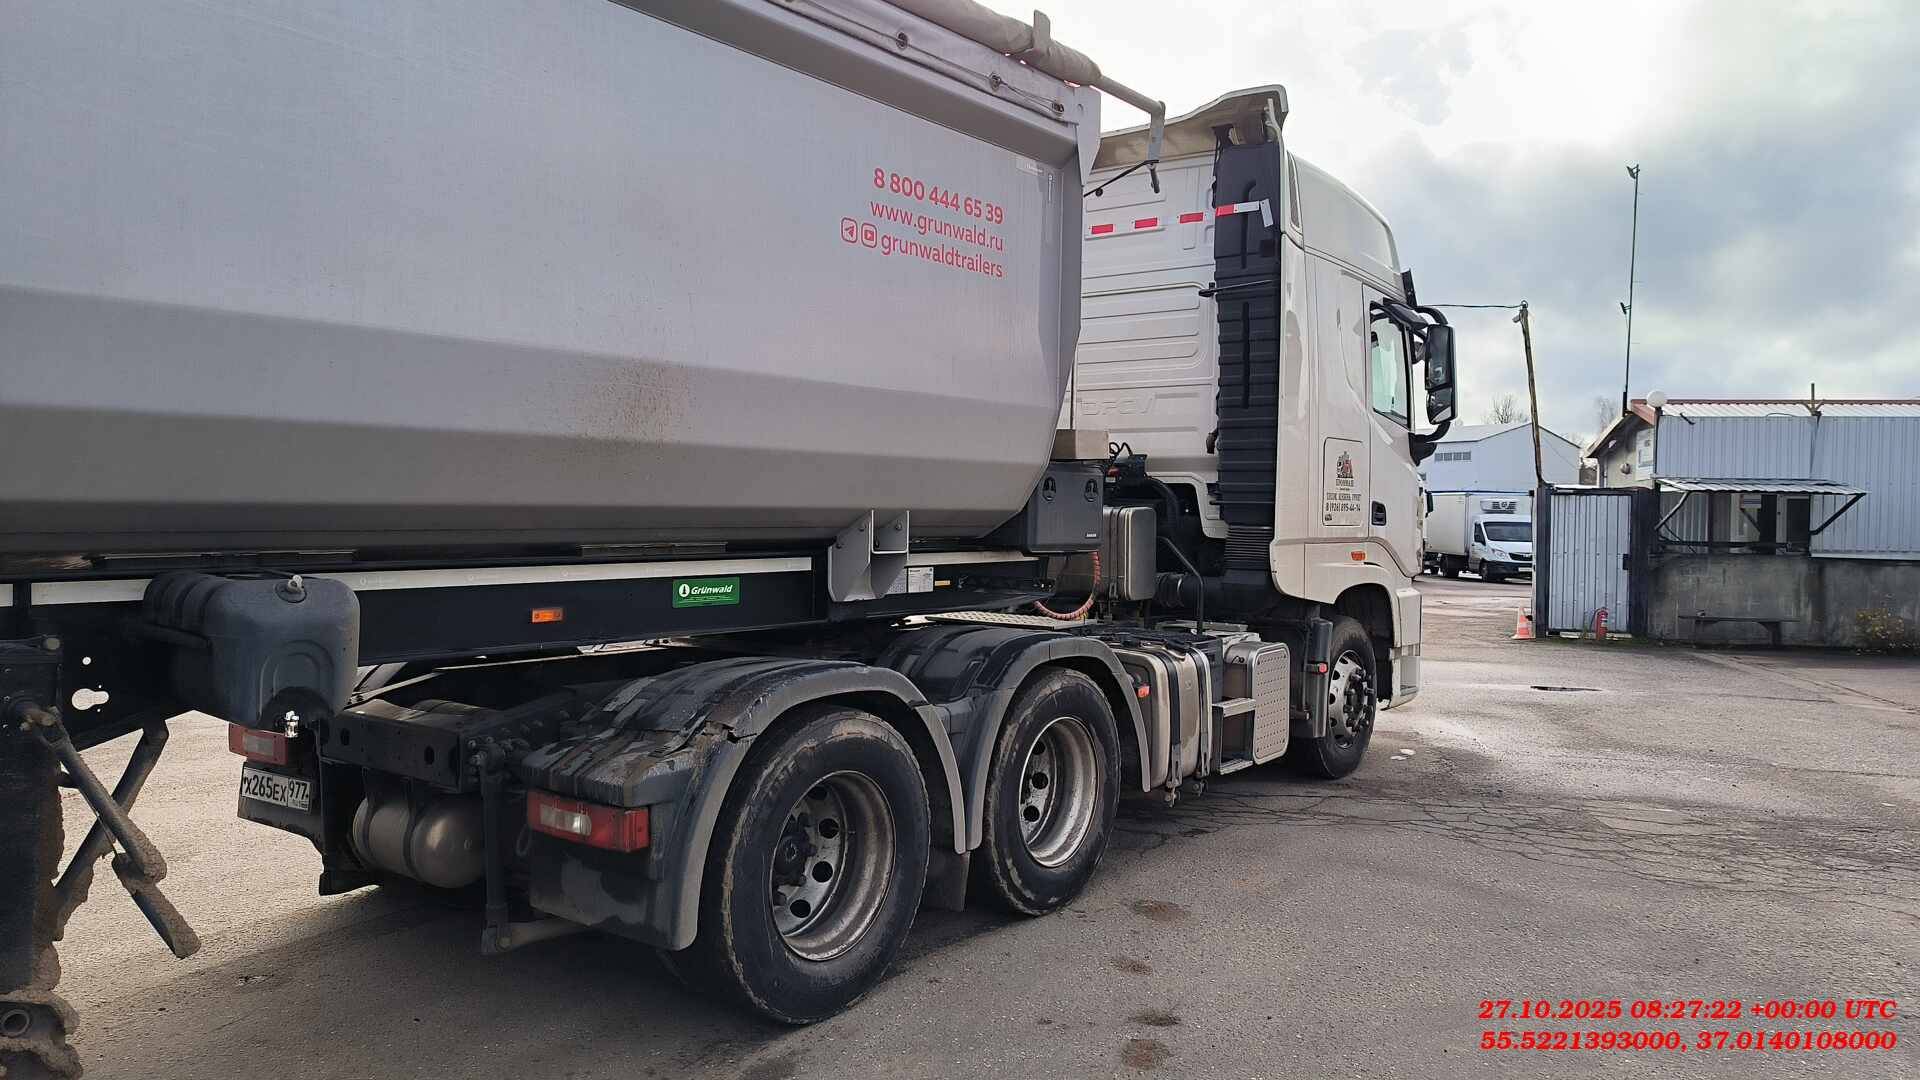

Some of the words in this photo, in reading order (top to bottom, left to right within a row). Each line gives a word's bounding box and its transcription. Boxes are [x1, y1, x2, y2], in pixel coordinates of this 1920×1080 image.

[873, 167, 886, 189] 8
[889, 172, 925, 201] 800
[928, 186, 960, 212] 444
[963, 196, 982, 218] 65
[985, 202, 1004, 225] 39
[870, 201, 1003, 251] www.grunwald.ru
[881, 234, 1003, 278] grunwaldtrailers
[691, 584, 733, 594] Grünwald
